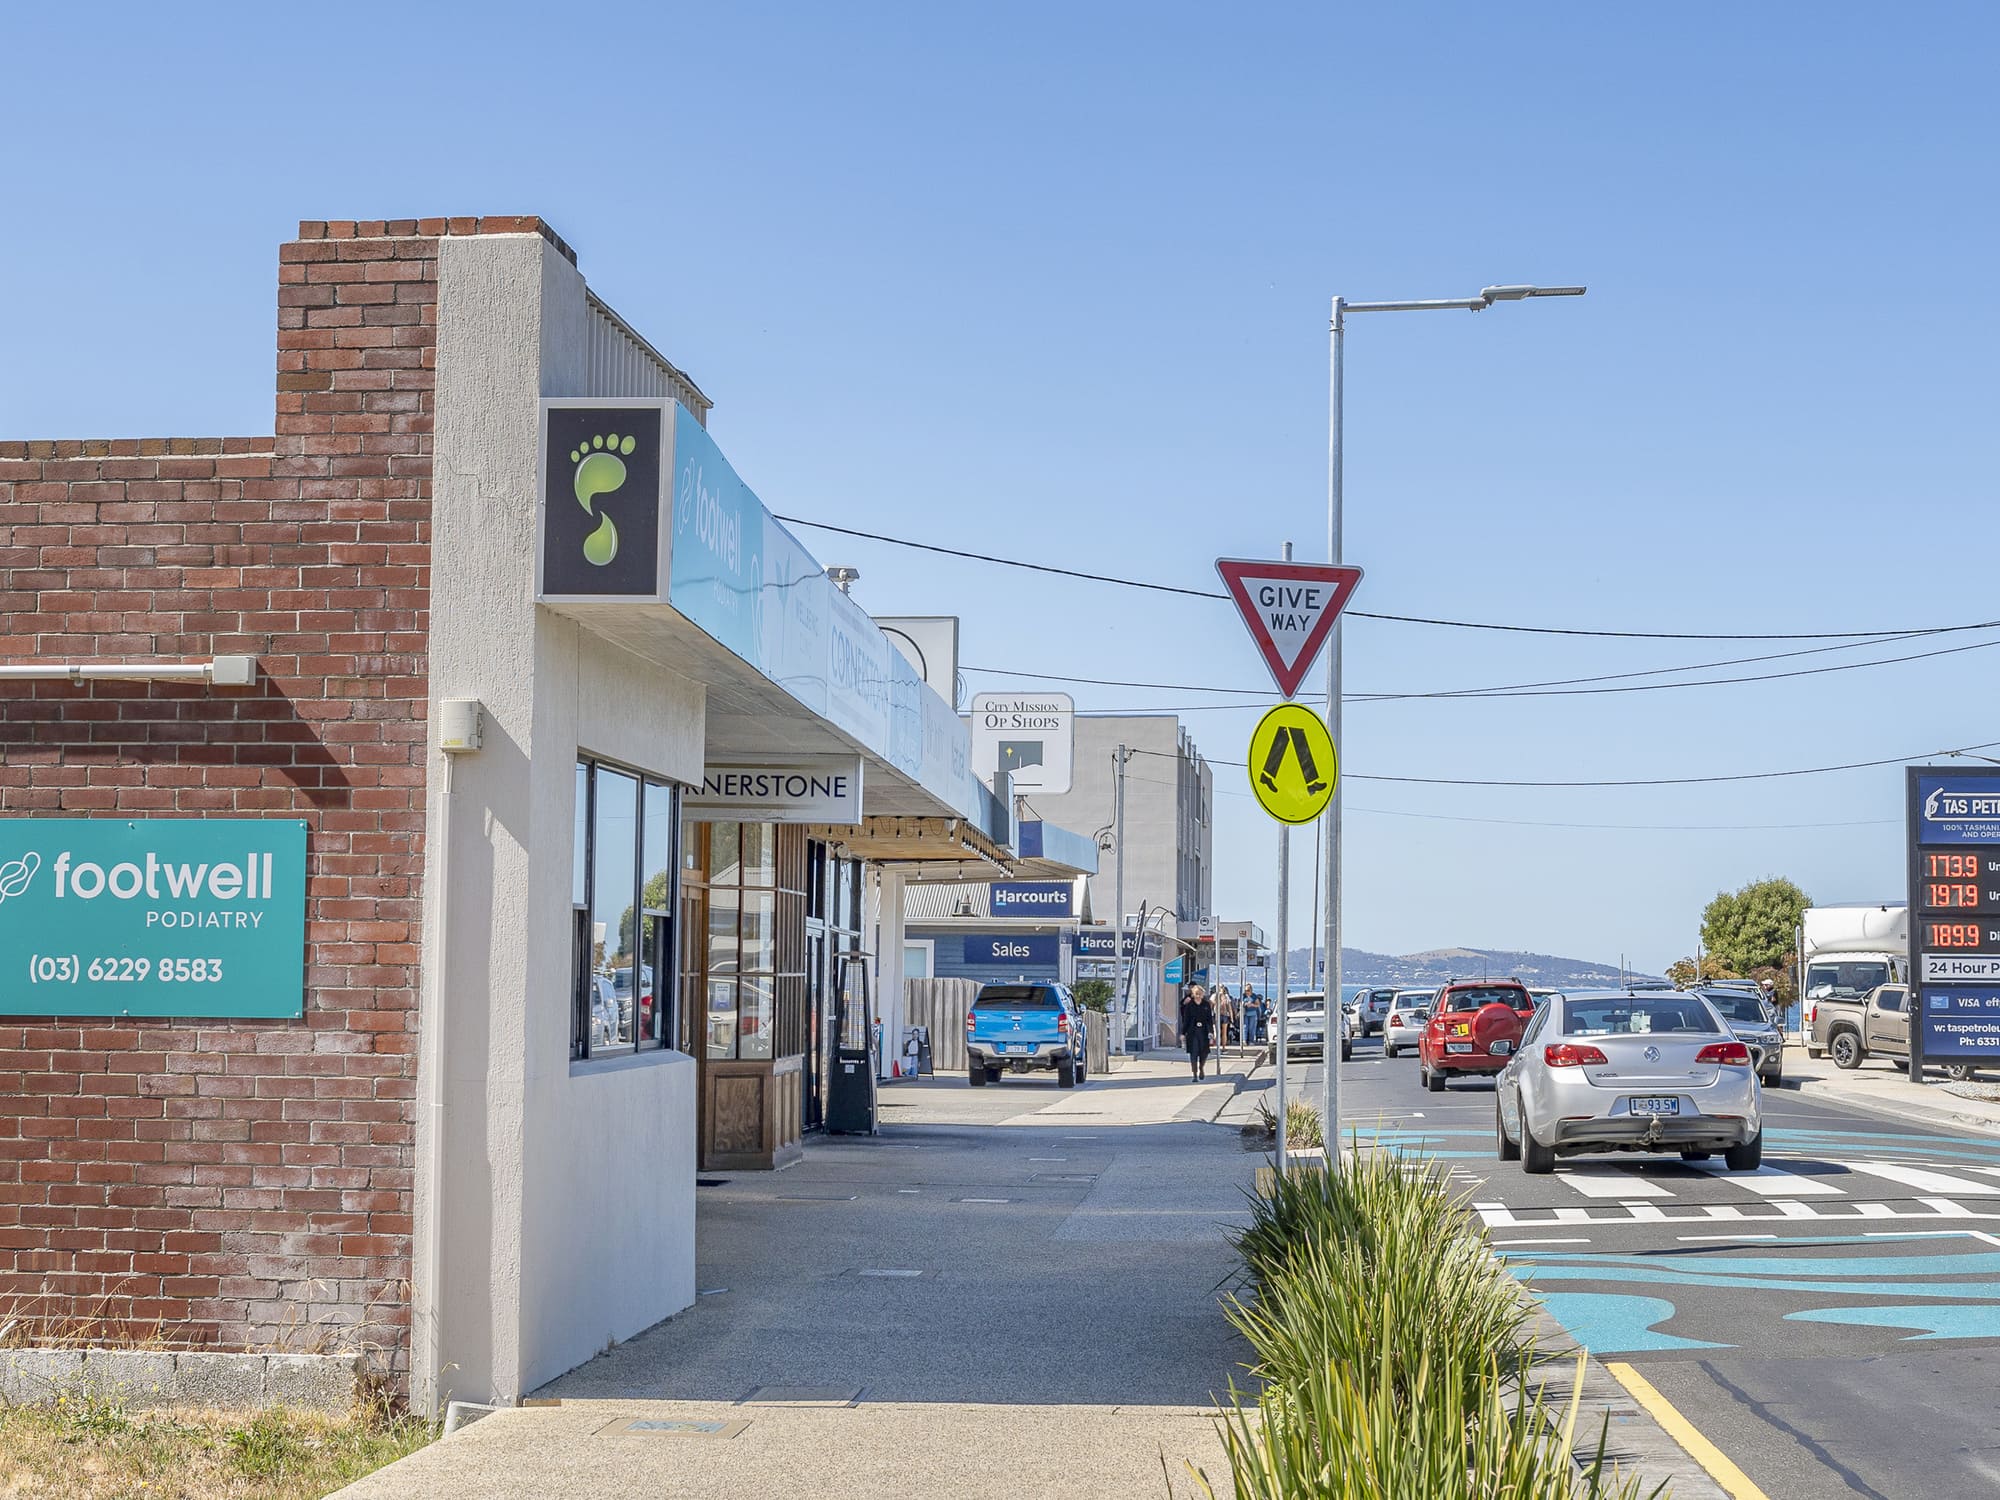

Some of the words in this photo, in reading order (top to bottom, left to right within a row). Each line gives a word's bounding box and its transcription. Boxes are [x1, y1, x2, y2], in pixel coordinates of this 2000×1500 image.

[695, 466, 741, 577] footwell
[1259, 586, 1321, 610] GIVE
[1271, 613, 1310, 631] WAY
[1943, 799, 1968, 814] TAS
[1930, 855, 1978, 877] 173.9
[53, 851, 273, 900] footwell
[996, 890, 1067, 903] Harcourts
[1930, 884, 1978, 907] 197.9
[146, 911, 264, 928] PODIATRY
[1080, 937, 1135, 949] Harcorts
[1932, 924, 1979, 947] 189.9
[992, 941, 1030, 957] Sales
[29, 954, 80, 983] (03)
[88, 957, 150, 981] 6229
[158, 957, 223, 982] 8583
[1929, 962, 1948, 974] 24
[1952, 962, 1987, 974] Hour
[1957, 998, 1980, 1008] VISA
[1985, 997, 2000, 1008] eft
[1460, 1026, 1467, 1034] L
[1934, 1024, 1946, 1032] w:
[1960, 1036, 1975, 1046] Ph:
[1977, 1036, 2000, 1046] 6331
[1648, 1100, 1661, 1110] 93
[1664, 1100, 1677, 1110] SW
